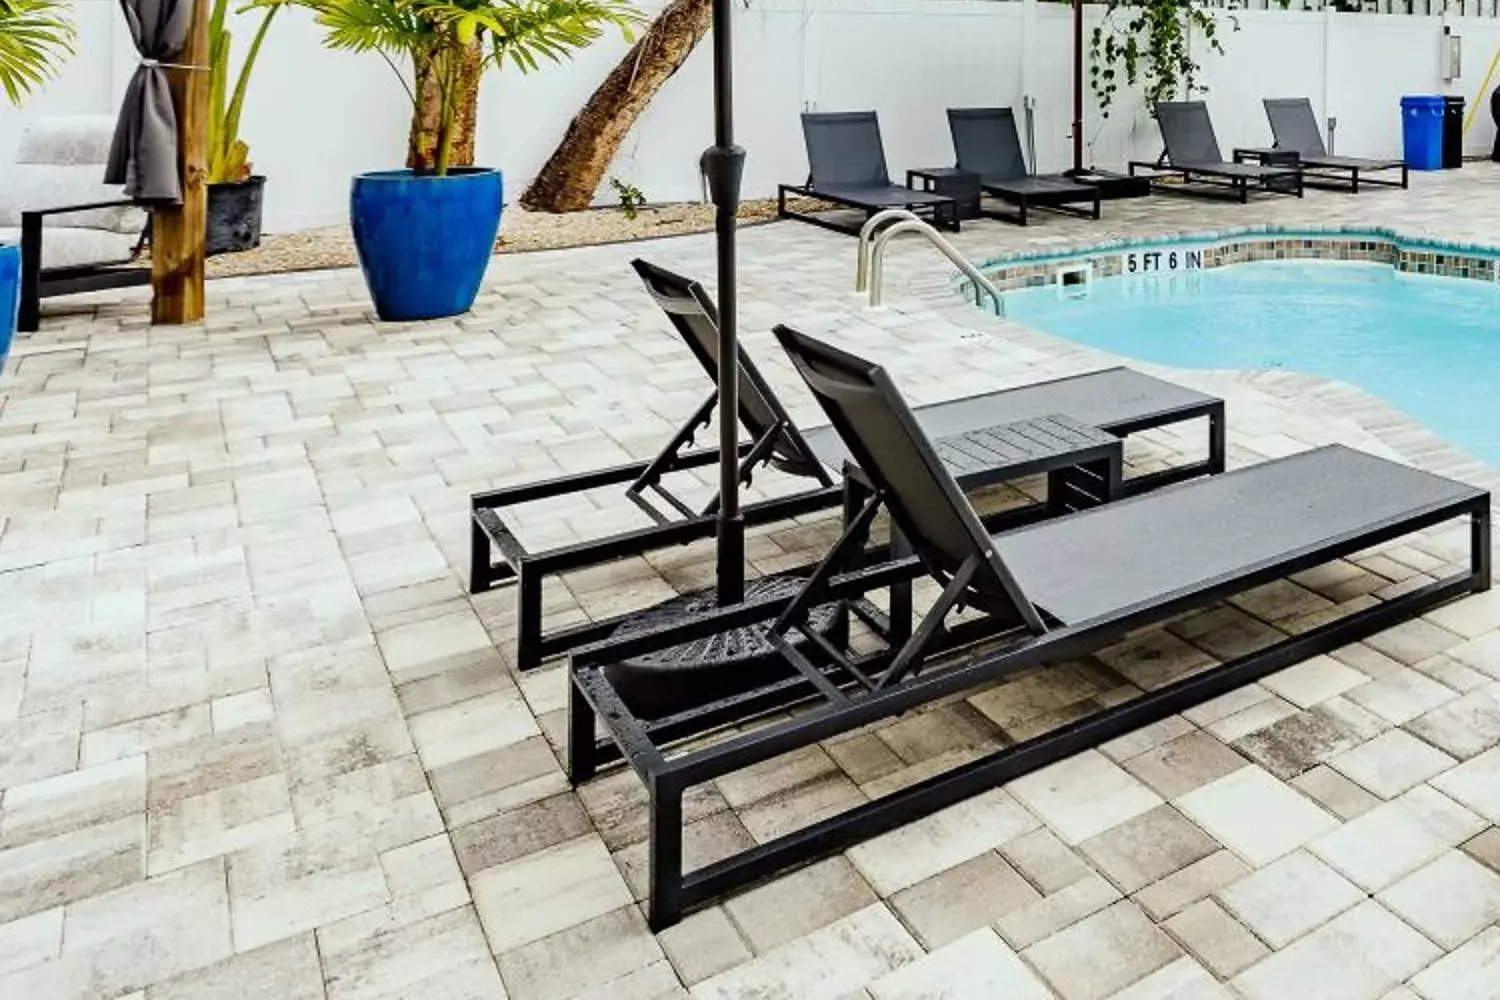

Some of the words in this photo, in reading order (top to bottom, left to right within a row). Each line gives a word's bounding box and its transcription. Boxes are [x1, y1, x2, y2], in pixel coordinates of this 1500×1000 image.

[1128, 253, 1137, 273] 5
[1143, 252, 1162, 271] FT
[1169, 251, 1177, 269] 6
[1185, 250, 1201, 269] IN
